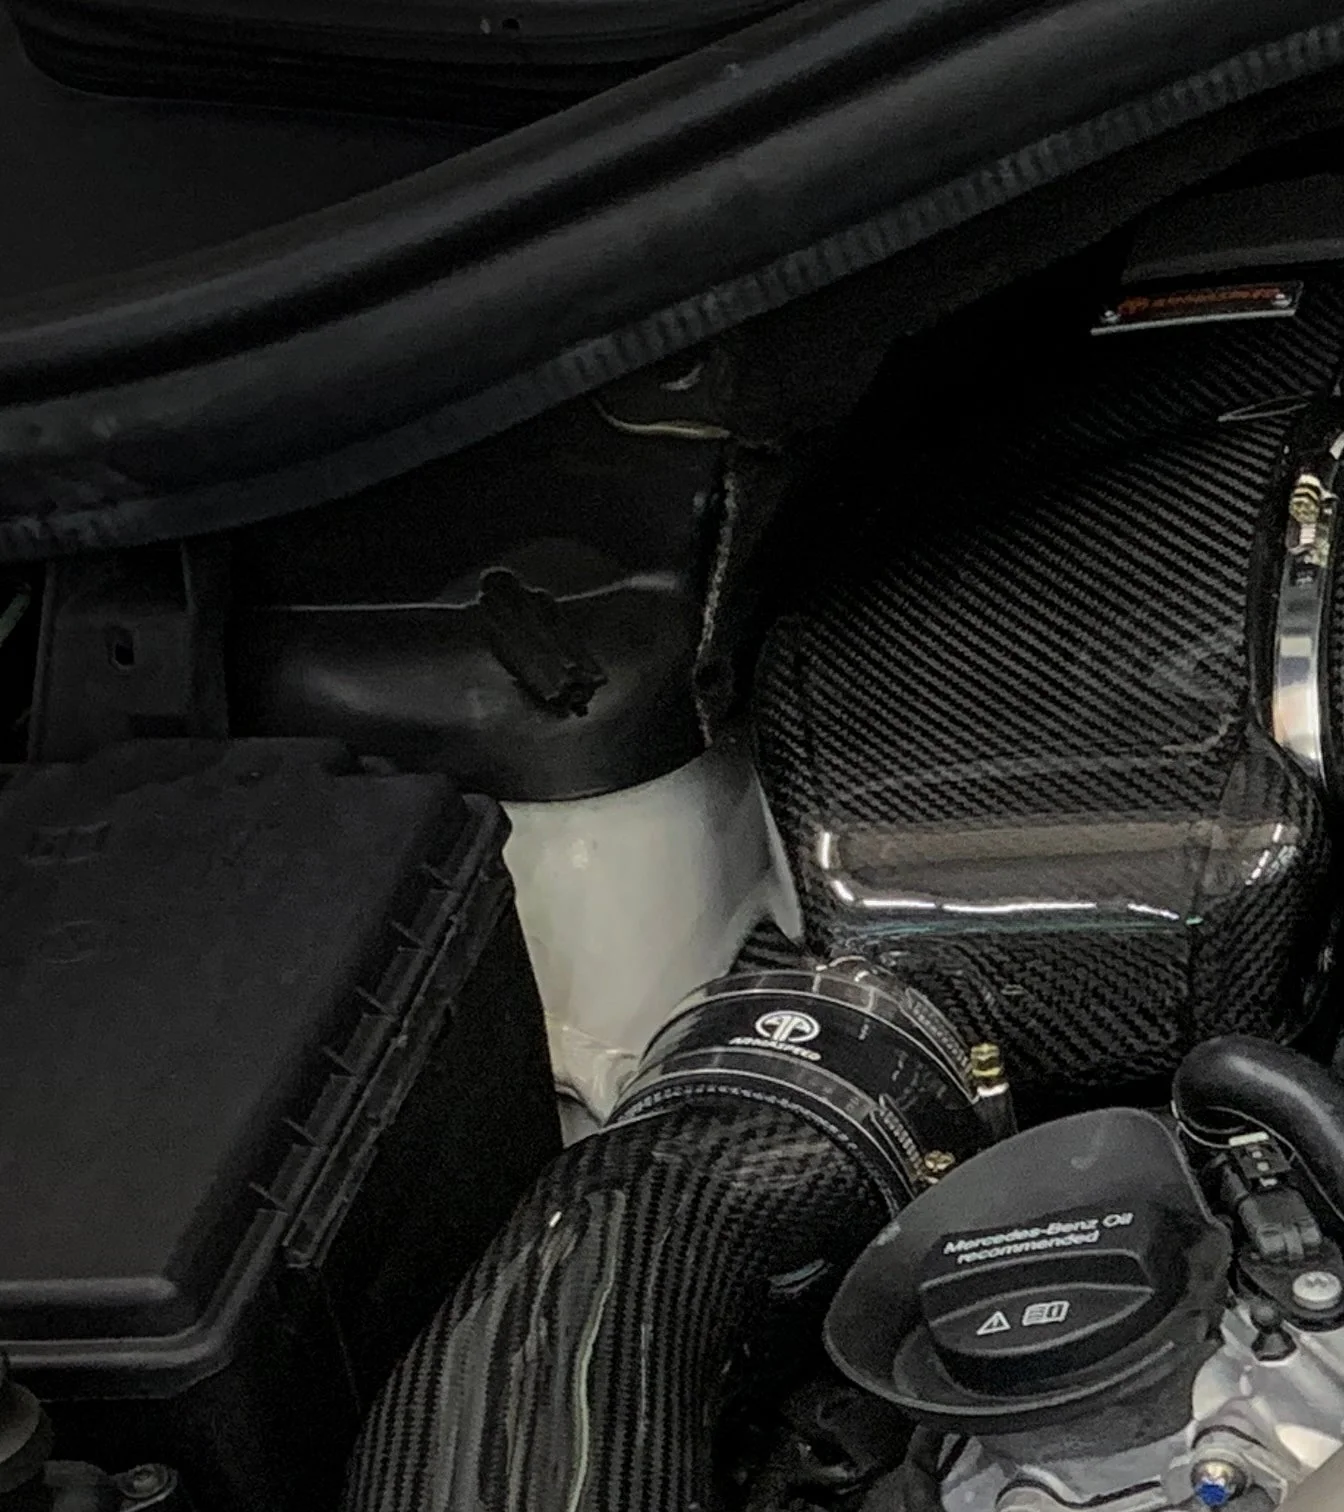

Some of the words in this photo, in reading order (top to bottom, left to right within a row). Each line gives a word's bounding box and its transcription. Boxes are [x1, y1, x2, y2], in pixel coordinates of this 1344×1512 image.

[943, 1219, 1099, 1254] Mercedes-Benz
[1102, 1212, 1134, 1228] Oil
[957, 1230, 1099, 1264] recommended
